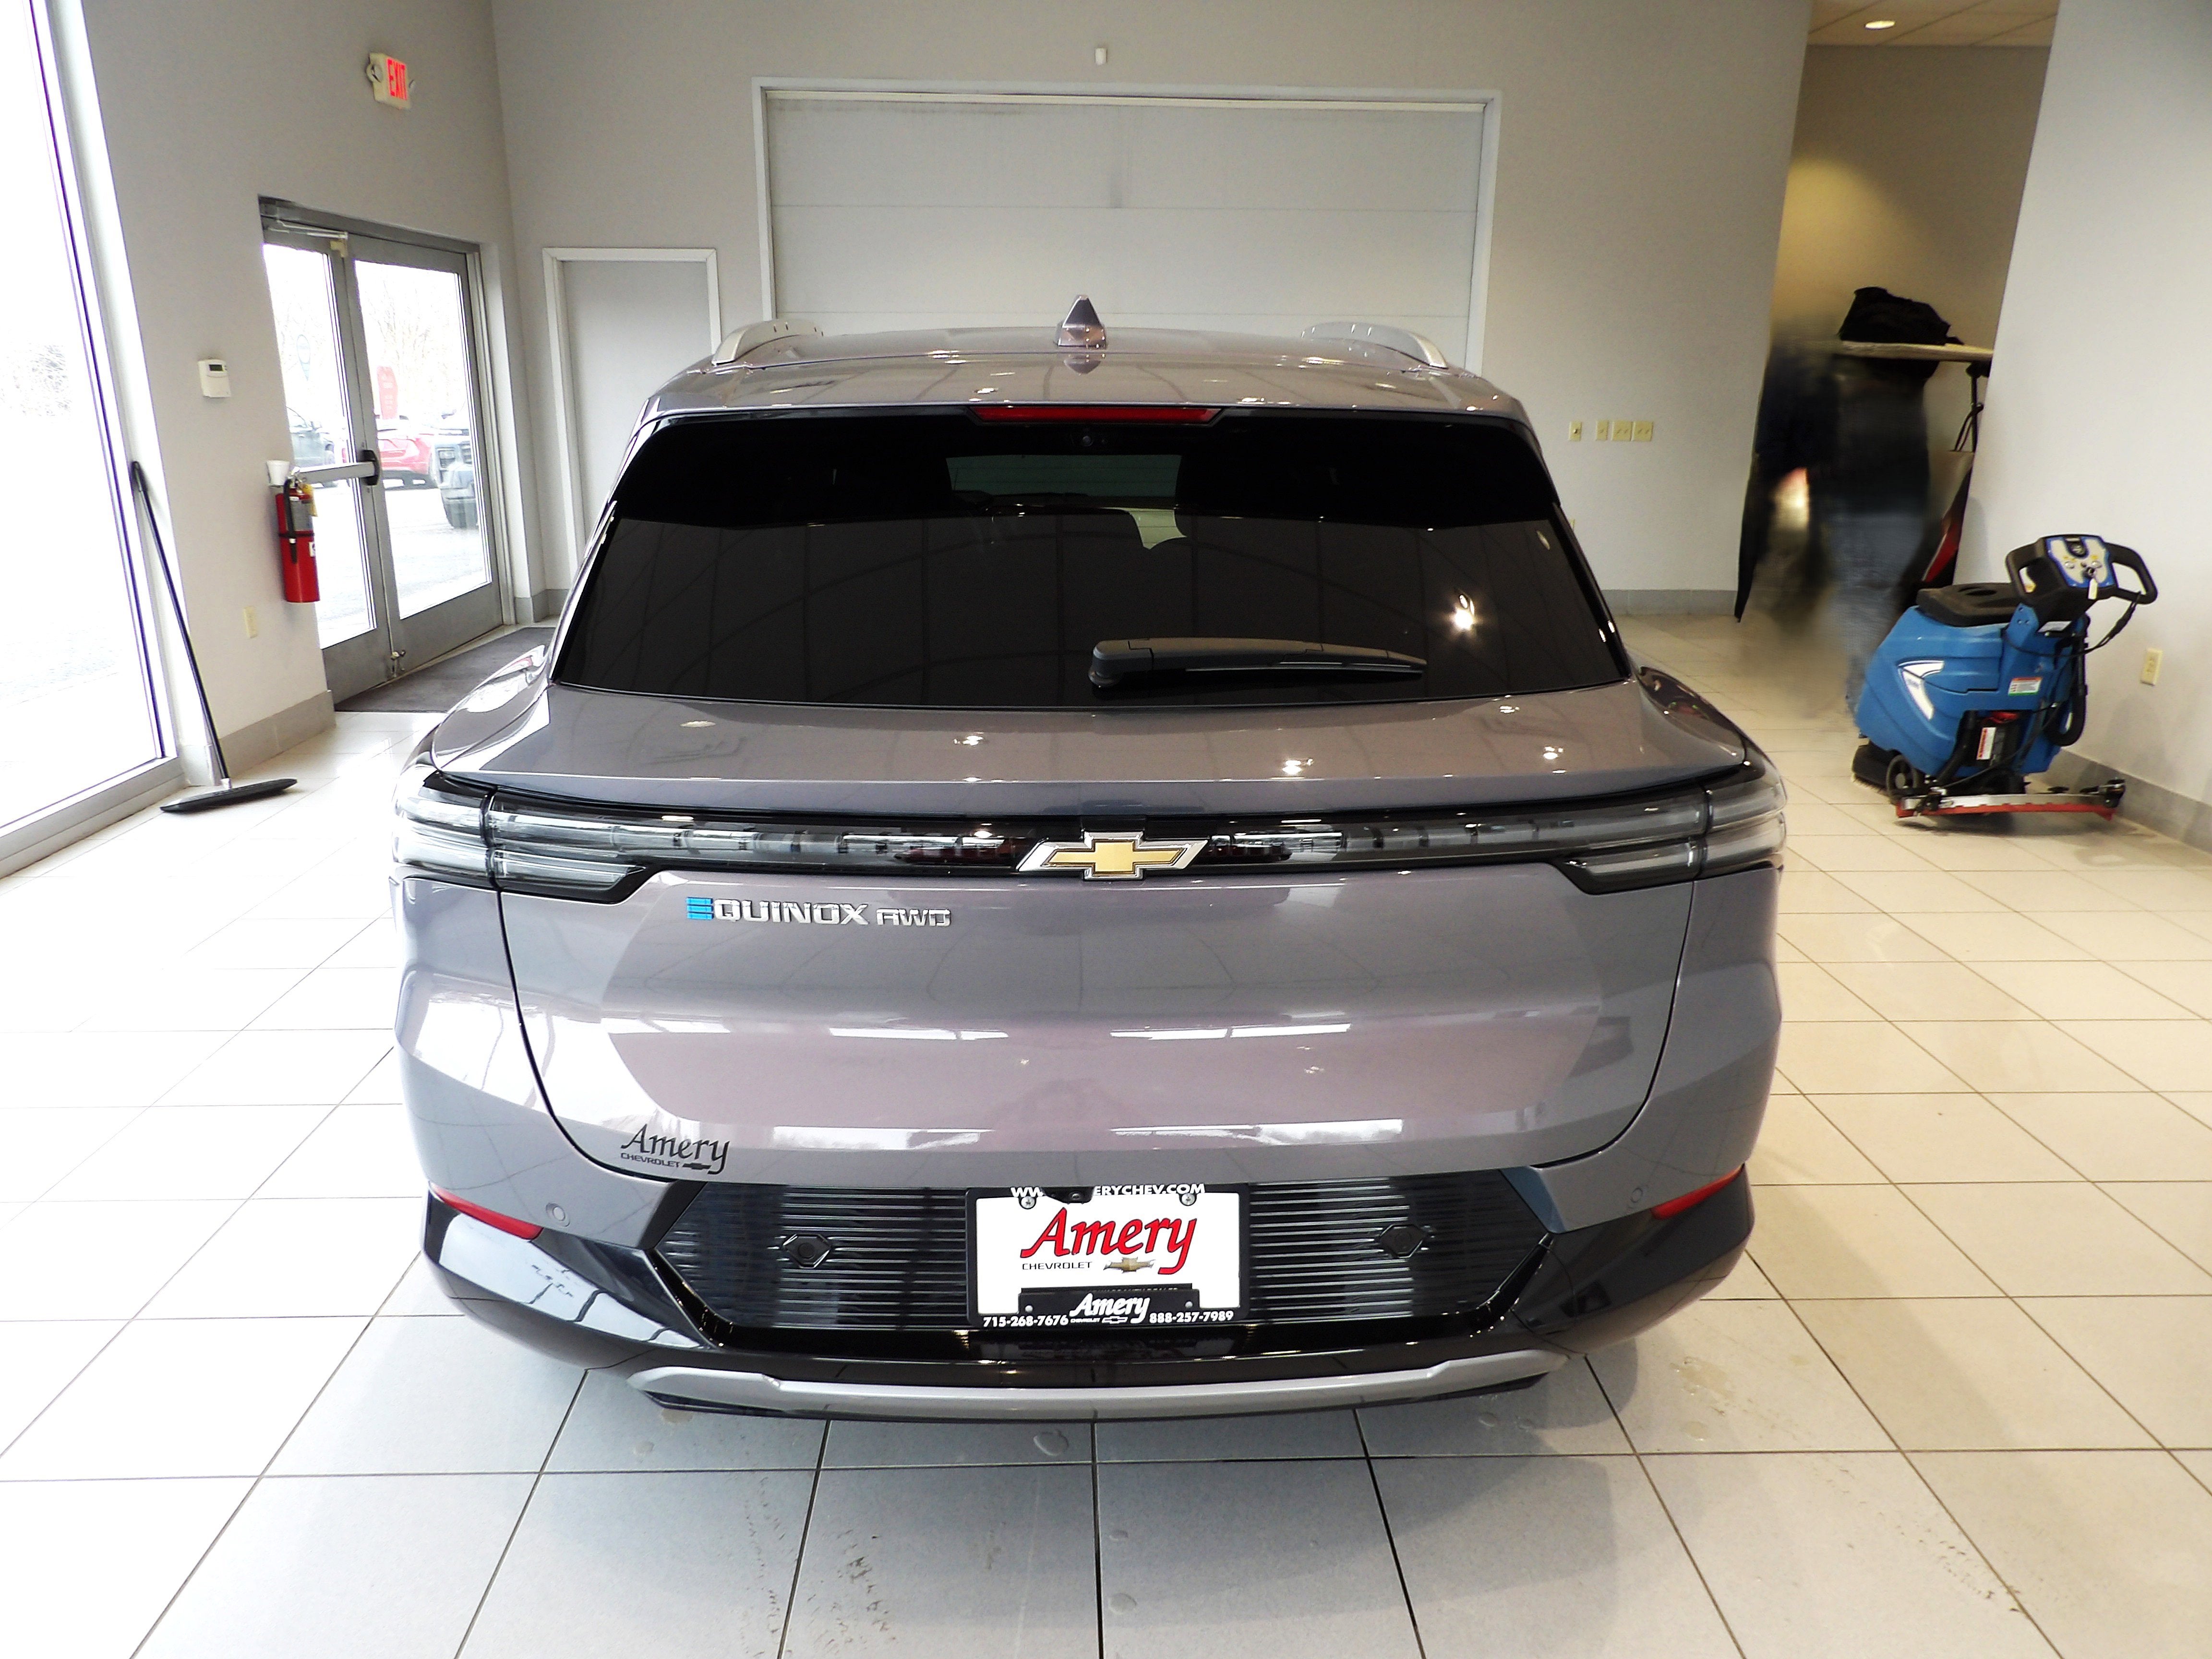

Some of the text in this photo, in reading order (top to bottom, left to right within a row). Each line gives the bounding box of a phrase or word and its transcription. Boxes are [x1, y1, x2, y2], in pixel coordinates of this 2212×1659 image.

[387, 59, 407, 100] EXIT
[685, 897, 951, 927] EQUINOX AWD
[620, 1123, 730, 1175] Amery
[620, 1153, 680, 1168] CHEVROLET
[1010, 1183, 1205, 1198] WWERYCHEV.COM
[1020, 1207, 1198, 1275] Amery
[1022, 1261, 1093, 1270] CHEVROLET
[1069, 1293, 1151, 1324] Amery
[1149, 1310, 1234, 1323] 888-257-7989
[983, 1314, 1069, 1327] 715-268-7676
